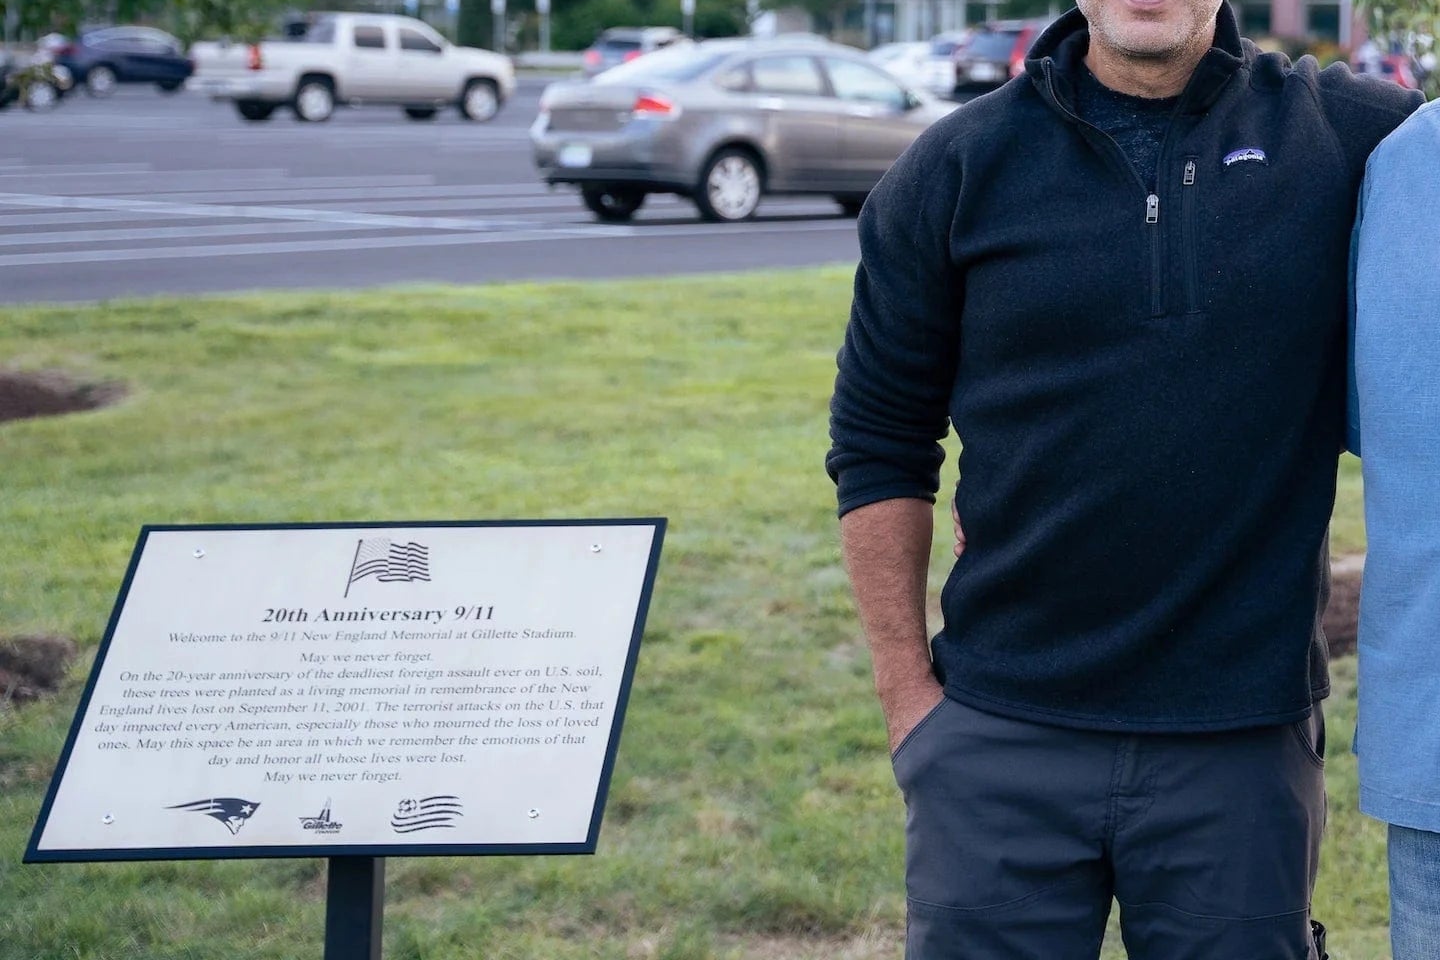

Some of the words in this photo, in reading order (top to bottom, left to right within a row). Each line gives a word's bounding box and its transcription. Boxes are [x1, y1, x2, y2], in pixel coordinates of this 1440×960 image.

[262, 609, 308, 622] 20th
[313, 607, 447, 625] Anniversary
[454, 606, 494, 620] 9/11
[168, 632, 227, 642] Welcome
[230, 633, 243, 642] to
[246, 632, 266, 642] the
[270, 631, 296, 641] 9/11
[300, 631, 331, 641] New
[334, 630, 388, 643] England
[390, 630, 453, 640] Memorial
[456, 630, 468, 639] at
[471, 629, 518, 639] Gillette
[522, 628, 576, 639] Stadium.
[300, 652, 329, 665] May
[394, 651, 432, 663] forget.
[120, 671, 139, 681] On
[142, 671, 163, 681] the
[166, 670, 216, 684] 20-year
[218, 670, 294, 683] anniversary
[296, 669, 314, 679] of
[314, 669, 334, 679] the
[337, 669, 394, 679] deadliest
[398, 668, 444, 681] foreign
[446, 668, 490, 678] assault
[493, 670, 522, 678] ever
[545, 667, 572, 677] U.S.
[576, 666, 602, 678] soil,
[122, 688, 156, 698] these
[160, 689, 190, 698] trees
[228, 687, 277, 700] planted
[308, 686, 346, 699] living
[348, 685, 411, 696] memorial
[414, 685, 427, 695] in
[430, 684, 517, 695] remembrance
[520, 684, 536, 694] of
[537, 683, 558, 694] the
[560, 683, 592, 693] New
[100, 705, 154, 718] England
[156, 704, 188, 715] lives
[191, 704, 217, 714] lost
[238, 703, 308, 717] September
[312, 702, 330, 714] 11,
[334, 702, 370, 713] 2001.
[374, 702, 400, 712] The
[402, 701, 454, 712] terrorist
[456, 700, 502, 711] attacks
[524, 700, 545, 710] the
[548, 699, 576, 710] U.S.
[580, 699, 604, 709] that
[94, 722, 118, 735] day
[122, 721, 183, 735] impacted
[185, 724, 222, 734] every
[224, 720, 292, 732] American,
[296, 719, 361, 733] especially
[364, 719, 398, 729] those
[402, 718, 430, 729] who
[432, 718, 491, 729] mourned
[494, 718, 514, 728] the
[517, 717, 542, 728] loss
[546, 717, 562, 727] of
[564, 717, 600, 727] loved
[98, 742, 131, 750] ones.
[136, 739, 166, 752] May
[170, 739, 194, 749] this
[196, 741, 234, 751] space
[237, 738, 254, 748] be
[275, 740, 303, 748] area
[307, 737, 320, 747] in
[324, 737, 363, 747] which
[367, 739, 386, 747] we
[388, 736, 456, 746] remember
[458, 735, 478, 745] the
[482, 735, 540, 745] emotions
[544, 734, 560, 744] of
[562, 734, 586, 744] that
[208, 755, 230, 768] day
[234, 755, 260, 765] and
[263, 754, 302, 765] honor
[304, 754, 322, 764] all
[326, 754, 367, 764] whose
[370, 753, 402, 764] lives
[440, 752, 466, 763] lost.
[264, 772, 294, 785] May
[360, 770, 402, 783] forget.
[303, 821, 343, 830] Gillette
